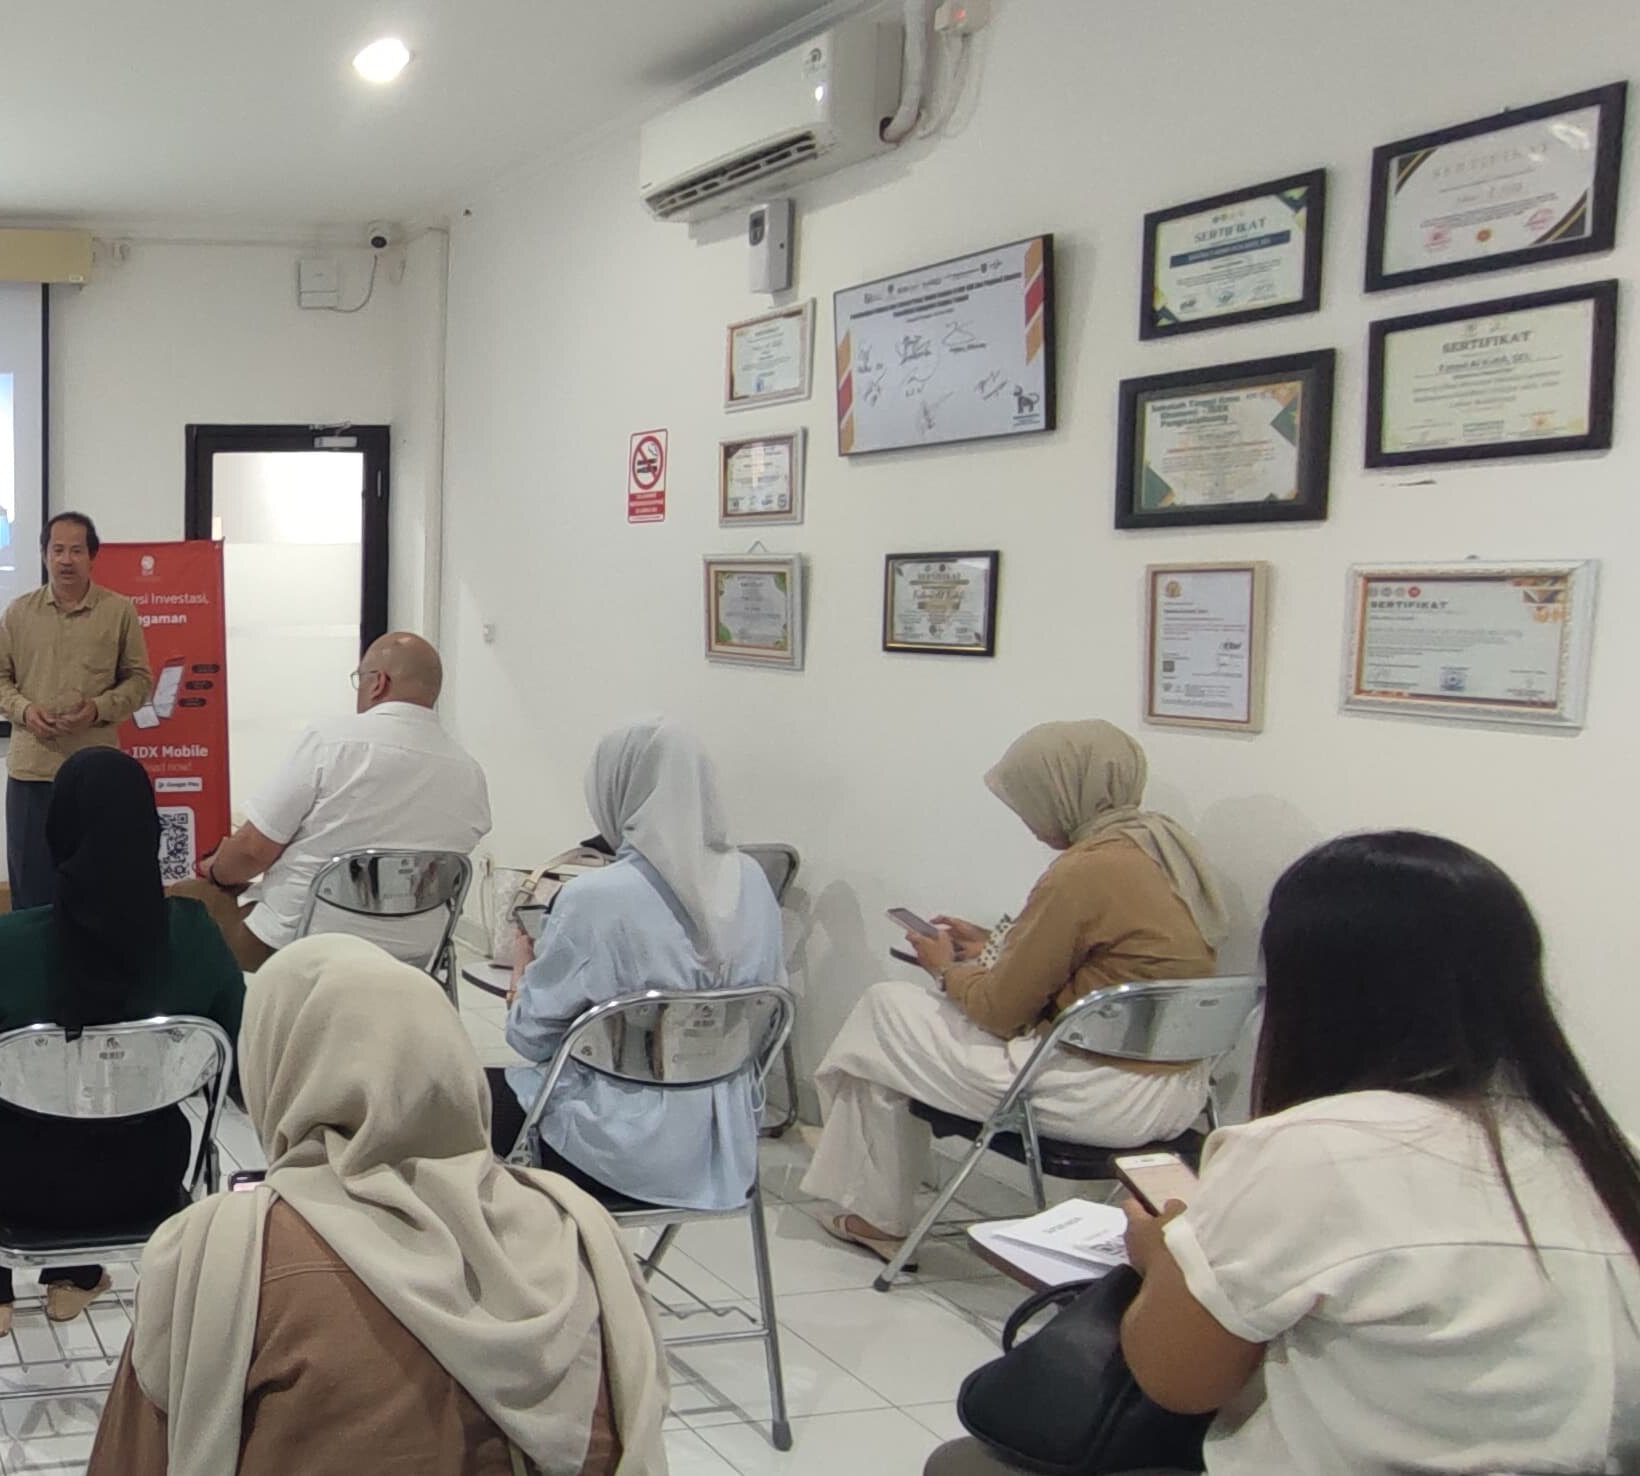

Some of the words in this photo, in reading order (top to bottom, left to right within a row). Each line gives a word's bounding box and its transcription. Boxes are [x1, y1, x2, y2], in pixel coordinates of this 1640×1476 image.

[1194, 217, 1267, 243] SERTIFIKAT
[1442, 330, 1533, 353] SERTIFIKAT
[151, 592, 210, 606] Investasi,
[1370, 600, 1449, 610] SERTIFIKAT
[132, 745, 158, 759] IDX
[162, 744, 209, 758] Mobile
